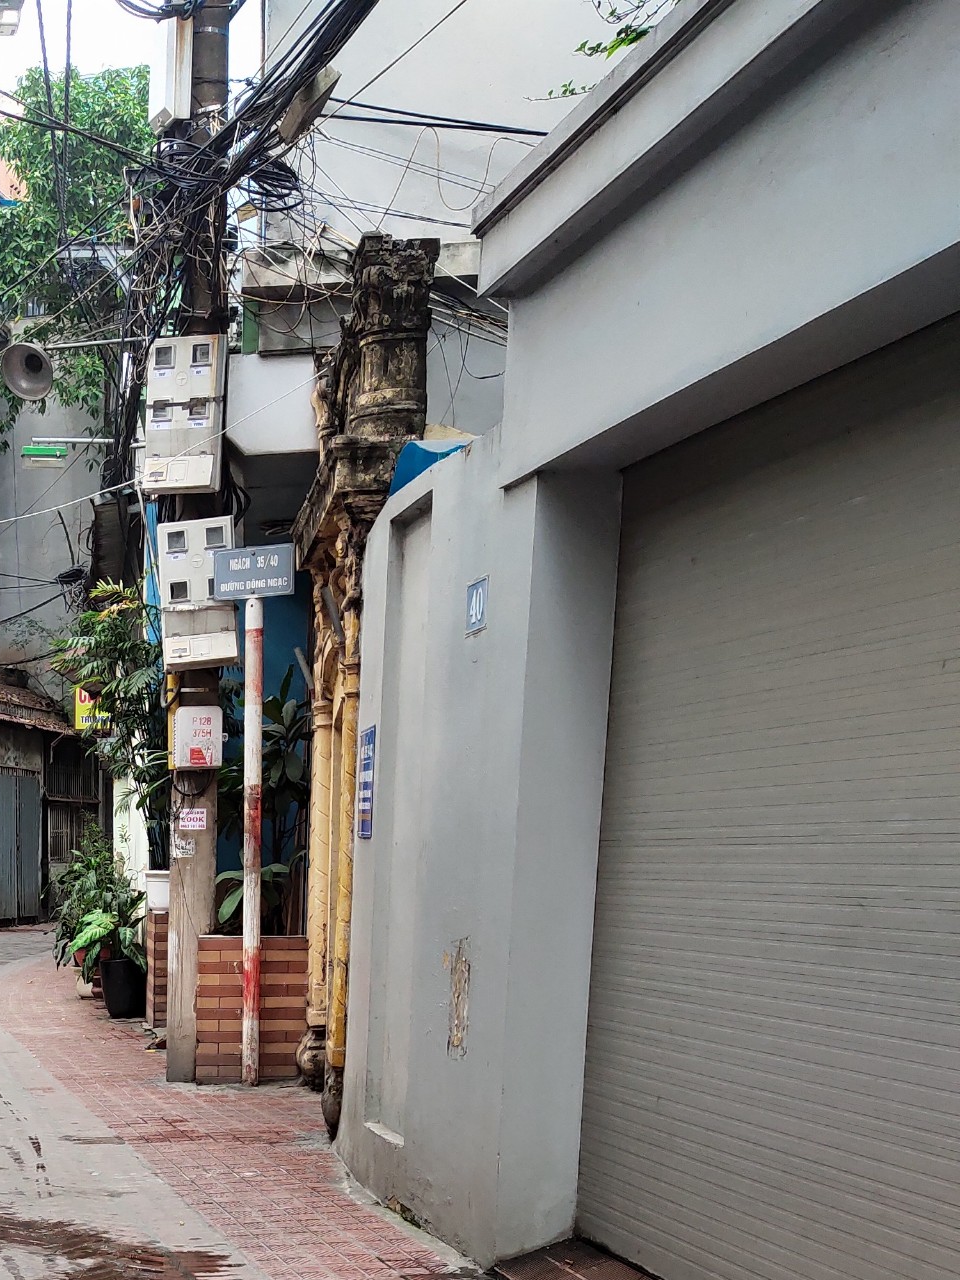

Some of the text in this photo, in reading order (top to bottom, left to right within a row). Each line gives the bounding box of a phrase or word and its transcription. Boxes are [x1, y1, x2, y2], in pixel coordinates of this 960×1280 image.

[229, 554, 279, 571] NGÁCH 35/40
[246, 578, 266, 590] ĐÔNG
[267, 577, 288, 589] NGẠC
[469, 587, 483, 623] 40
